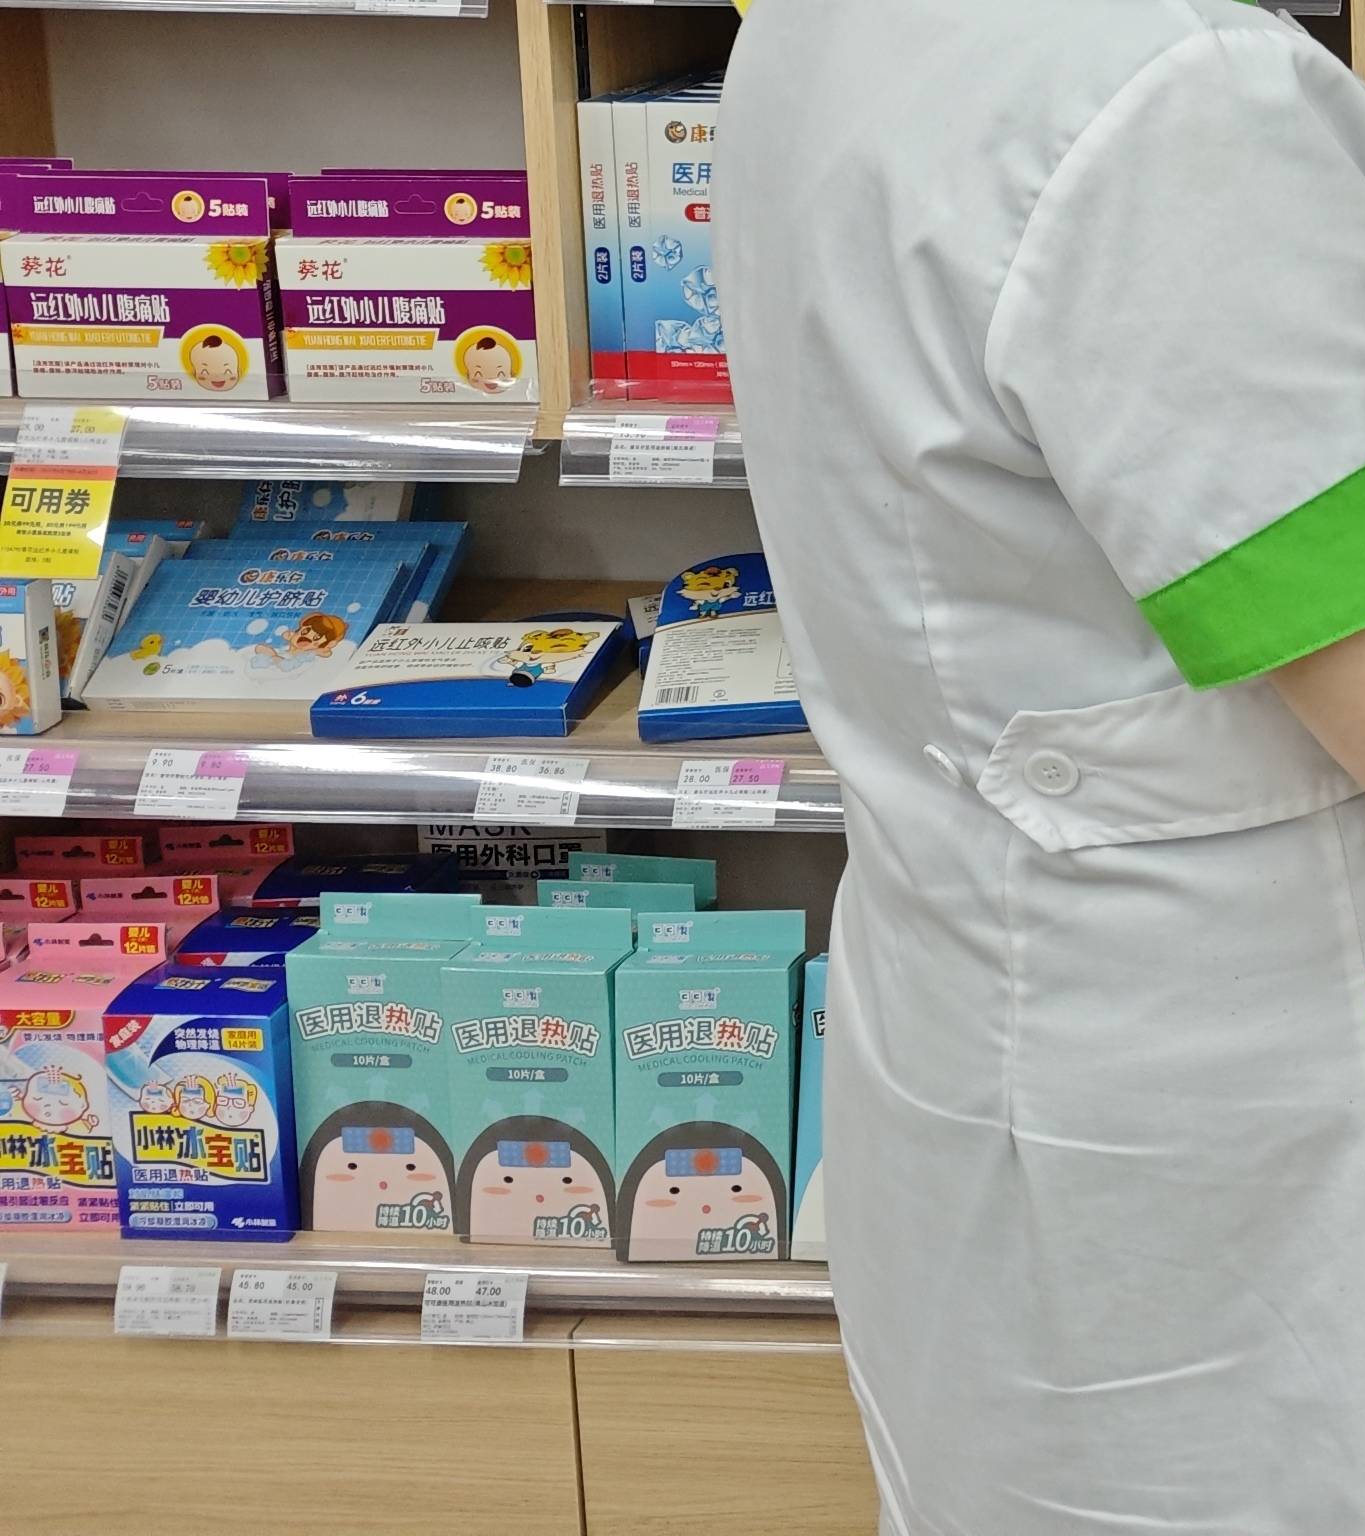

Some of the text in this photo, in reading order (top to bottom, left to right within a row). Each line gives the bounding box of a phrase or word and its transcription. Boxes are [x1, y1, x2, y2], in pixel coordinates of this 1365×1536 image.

[208, 200, 250, 218] 5贴装
[481, 202, 522, 220] 5贴装
[21, 255, 68, 278] 葵花
[31, 292, 170, 324] 远红外小儿腹痛贴
[306, 295, 445, 326] 远红外小儿腹痛贴
[190, 588, 326, 609] 婴幼儿护脐贴
[367, 636, 510, 653] 远红外小儿止咳贴
[623, 1019, 778, 1059] 医用退热贴
[352, 1054, 391, 1066] 10片/盒
[508, 1068, 546, 1080] 10片/盒
[680, 1073, 720, 1085] 10片/盒
[135, 1122, 263, 1179] 小林冰宝贴
[425, 1287, 502, 1296] 48.00 47.00
